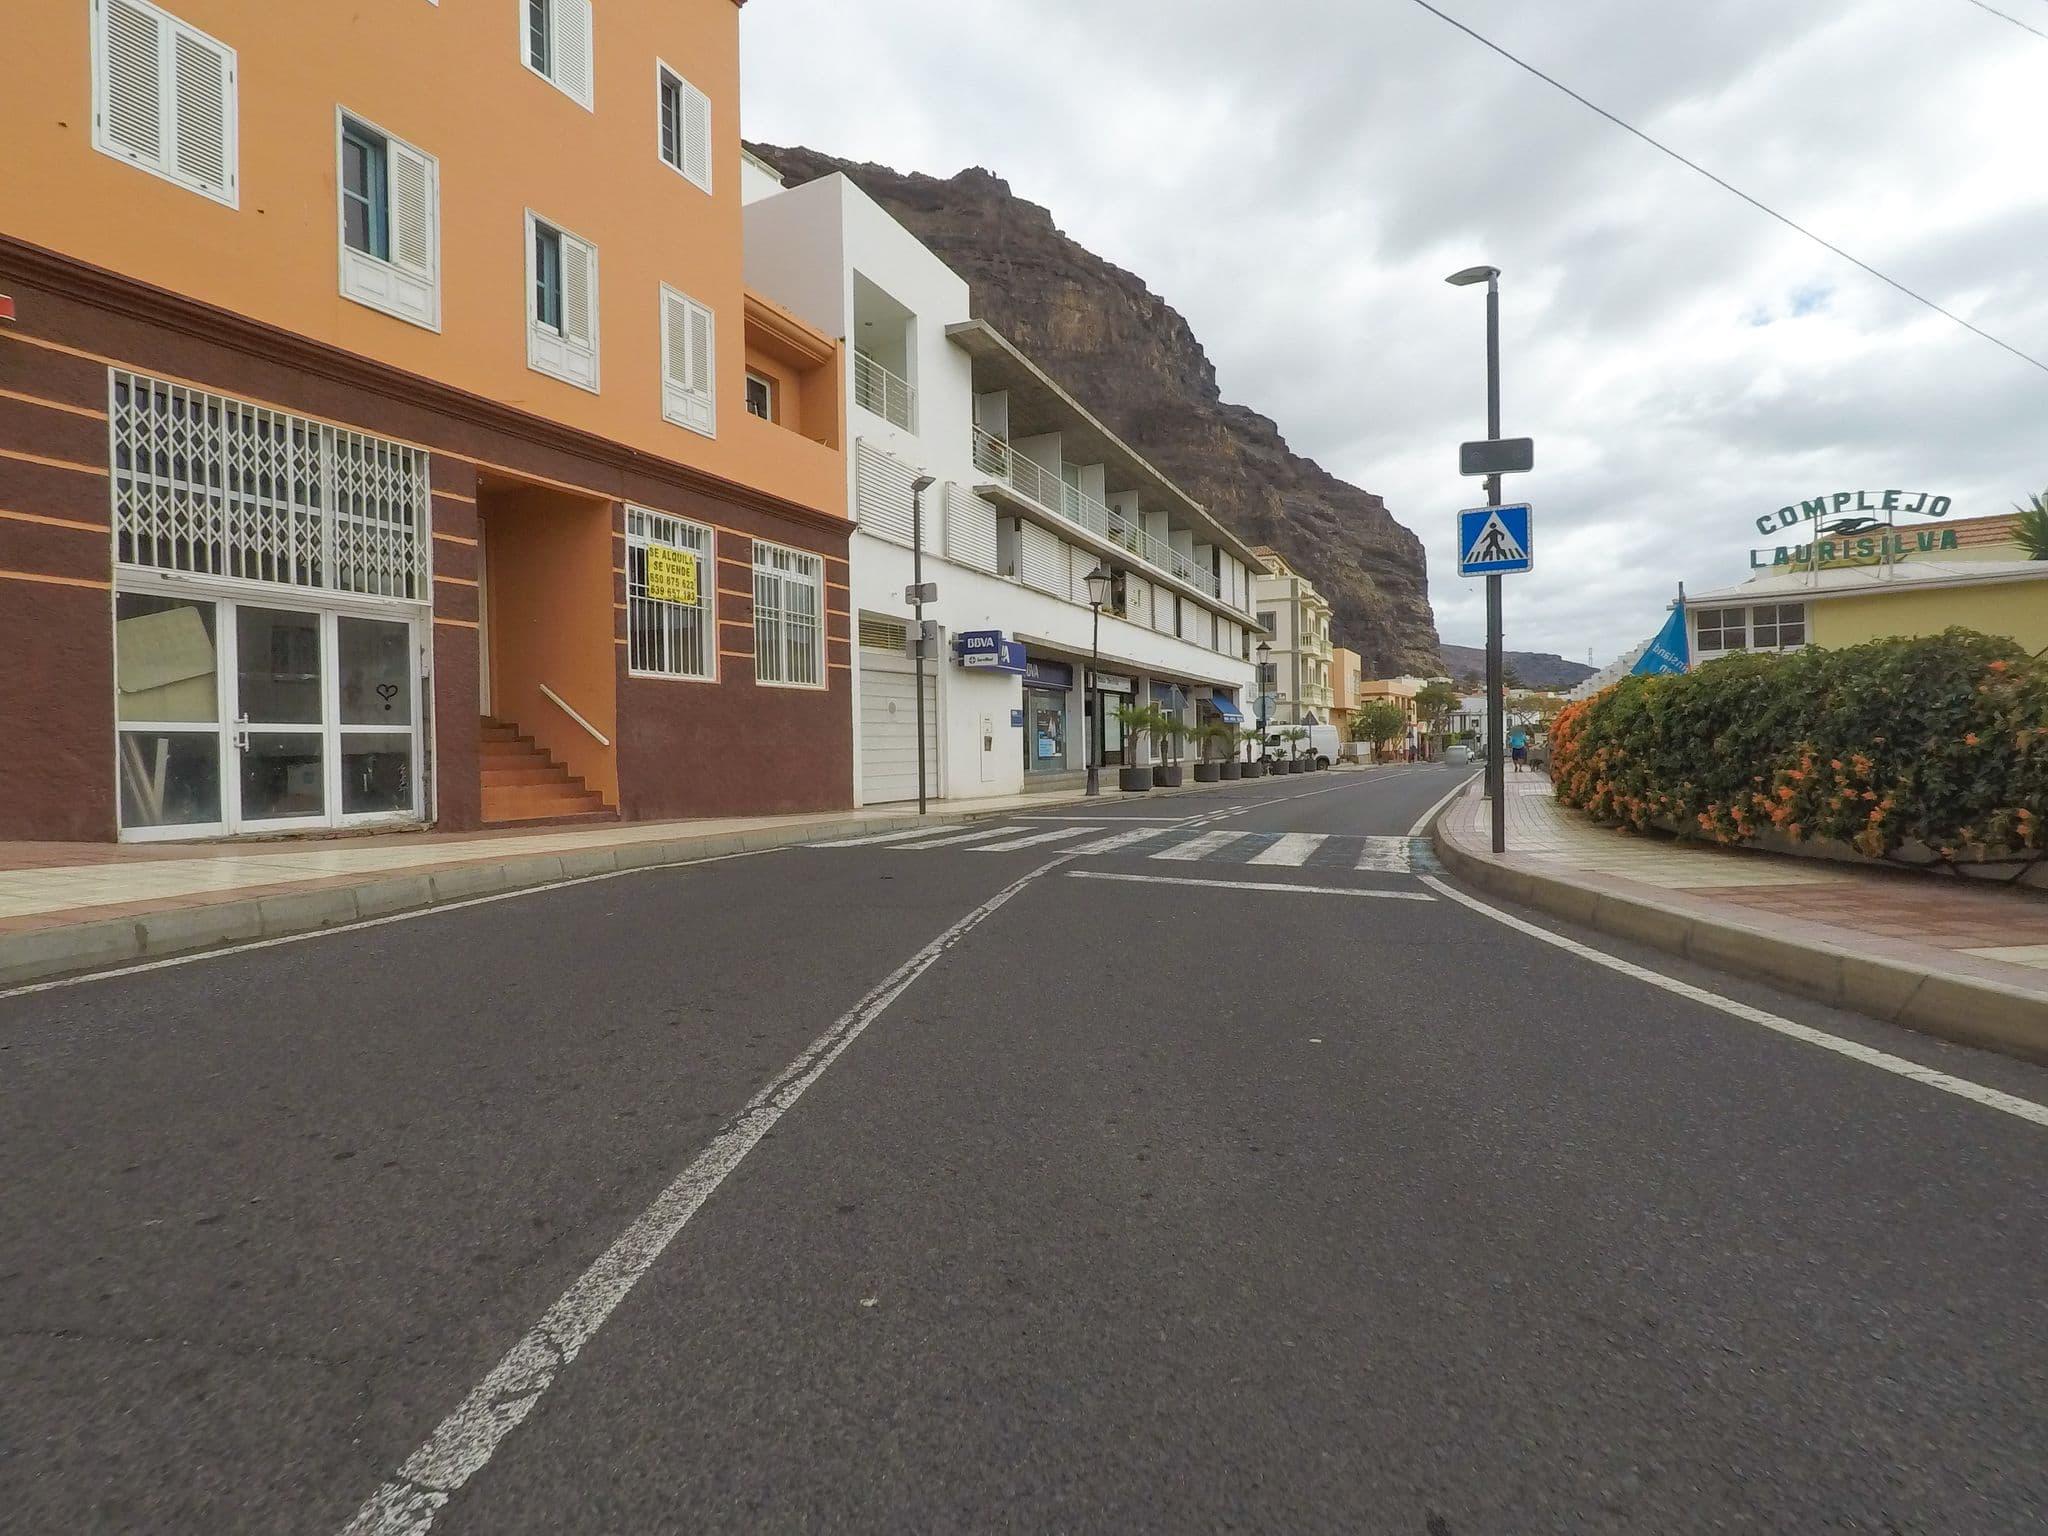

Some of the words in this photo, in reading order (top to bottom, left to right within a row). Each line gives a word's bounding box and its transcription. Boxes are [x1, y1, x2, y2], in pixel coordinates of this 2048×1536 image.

[1756, 489, 1951, 535] COMPLEJO
[649, 547, 660, 558] SE
[662, 550, 694, 566] ALQUILA
[1750, 529, 1958, 569] LAURISILVA
[653, 560, 663, 572] SE
[666, 563, 691, 577] VENDE
[967, 637, 995, 649] BBVA
